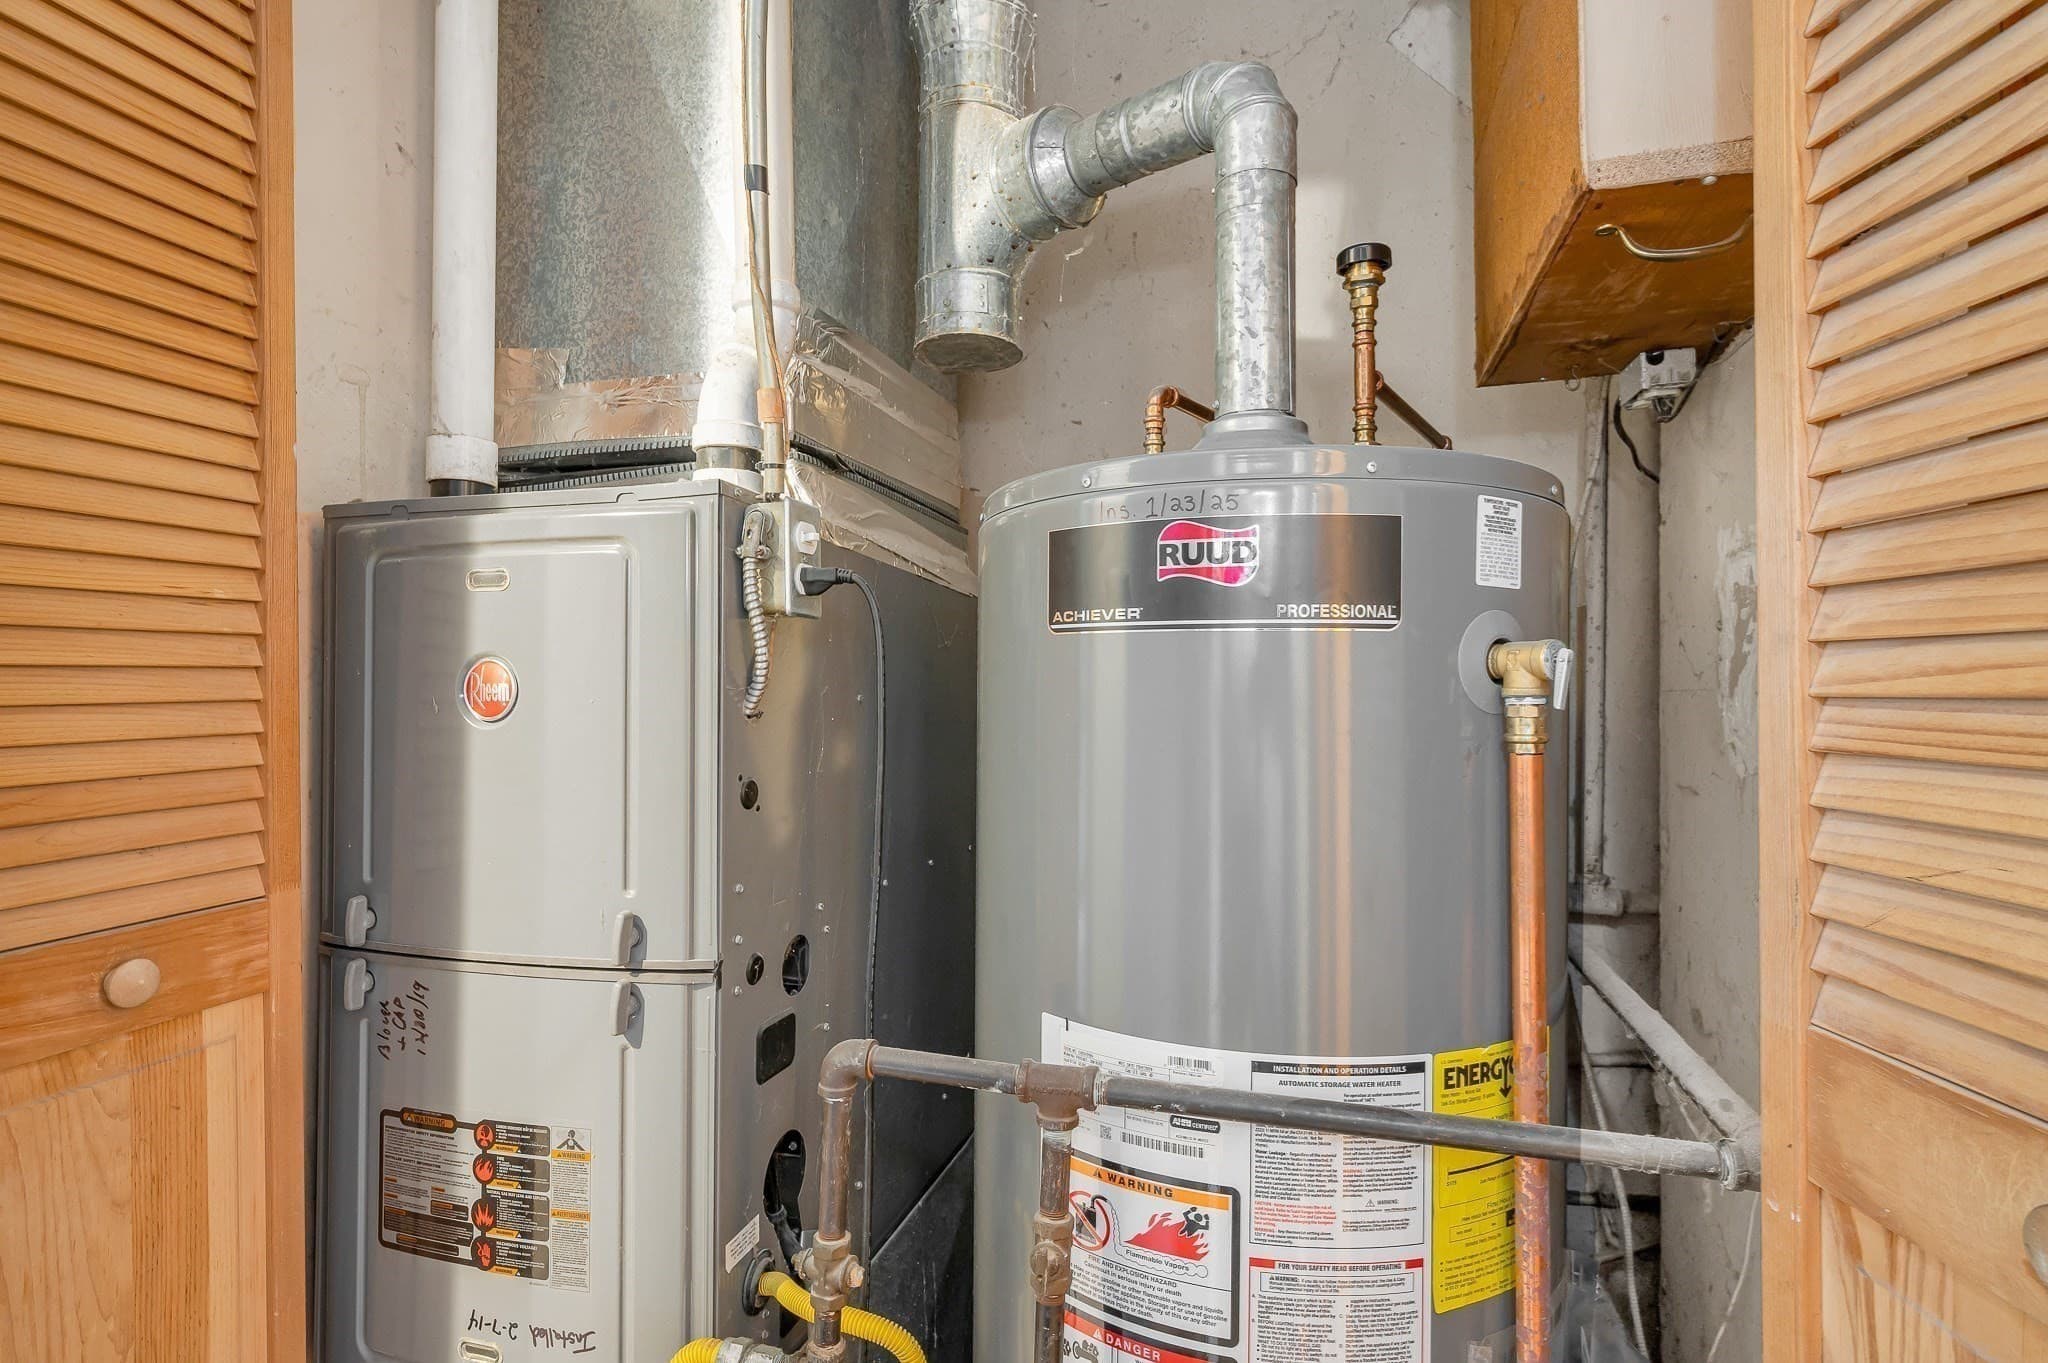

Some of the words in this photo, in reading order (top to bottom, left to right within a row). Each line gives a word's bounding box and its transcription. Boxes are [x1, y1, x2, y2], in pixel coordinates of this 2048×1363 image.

[1100, 501, 1137, 521] Ins.
[1145, 489, 1240, 518] 1/23/25
[1159, 540, 1257, 567] RUUD
[1052, 607, 1143, 623] ACHIEVER
[1276, 603, 1397, 618] PROFESSIONAL
[470, 664, 510, 710] Rheem
[392, 996, 407, 1030] CAP
[1273, 1065, 1322, 1074] INSTALLATION
[1380, 1065, 1407, 1073] DETAILS
[1444, 1055, 1514, 1096] ENERGY
[1376, 1080, 1401, 1088] HEATER
[411, 1113, 446, 1128] WARNING
[1107, 1172, 1173, 1197] WARNING
[1101, 1259, 1114, 1269] AND
[1114, 1264, 1149, 1281] EXPLOSION
[1150, 1275, 1177, 1288] HAZARD
[1125, 1249, 1163, 1264] Flammable
[1164, 1260, 1190, 1272] Vapors
[1278, 1262, 1290, 1270] FOR
[1308, 1264, 1330, 1272] SAFETY
[1371, 1263, 1402, 1271] OPERATING
[1117, 1274, 1138, 1285] serious
[1138, 1281, 1156, 1292] injury
[1164, 1289, 1182, 1297] death
[467, 1309, 519, 1341] 2-7-14
[529, 1324, 596, 1354] Installed
[1105, 1333, 1161, 1362] DANGER
